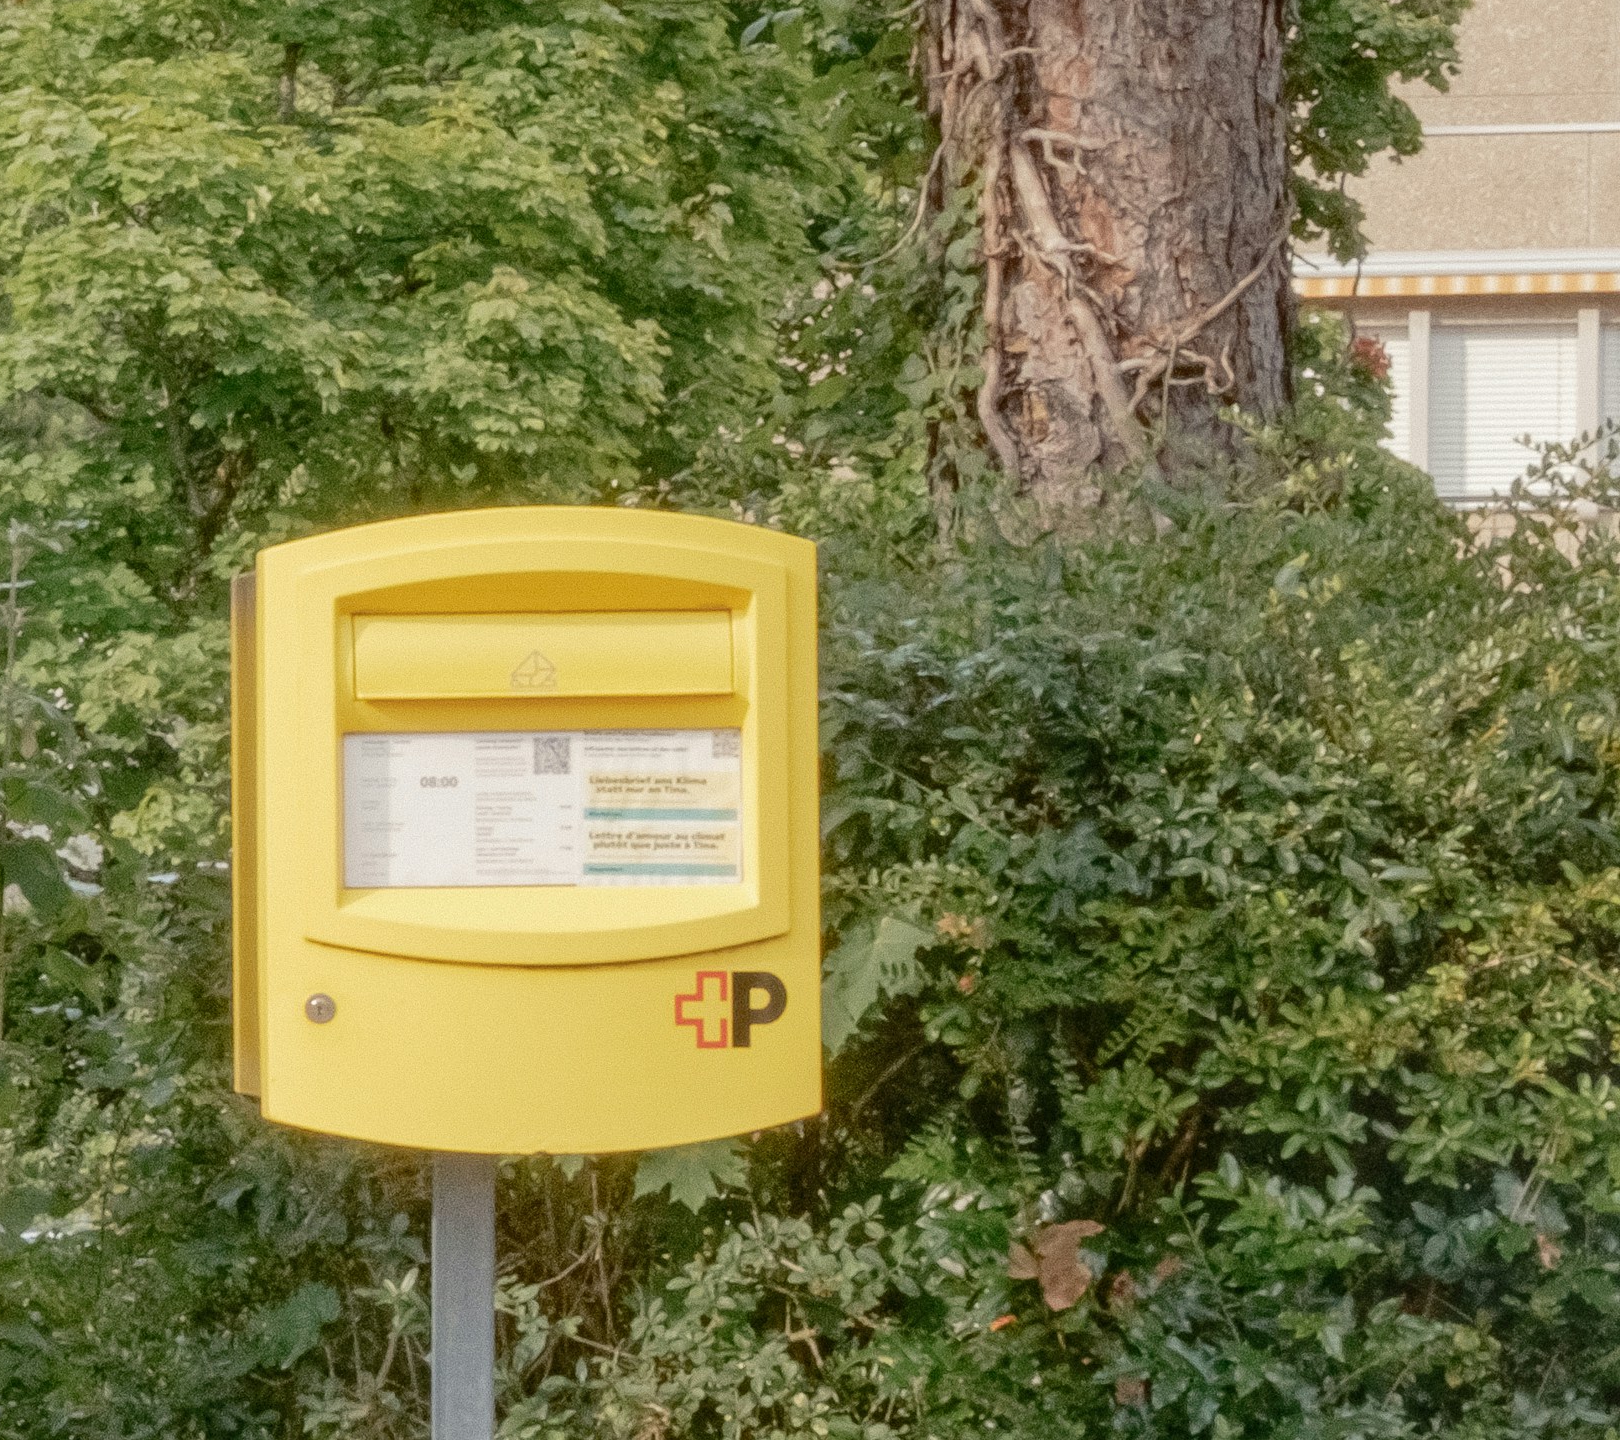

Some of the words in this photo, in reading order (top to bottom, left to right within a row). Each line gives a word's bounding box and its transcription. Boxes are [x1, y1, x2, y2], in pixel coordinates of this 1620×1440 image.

[420, 776, 459, 788] 08:00
[589, 776, 652, 785] Liebesbrief
[676, 776, 707, 785] Klima
[692, 832, 726, 840] climat
[631, 842, 651, 850] que
